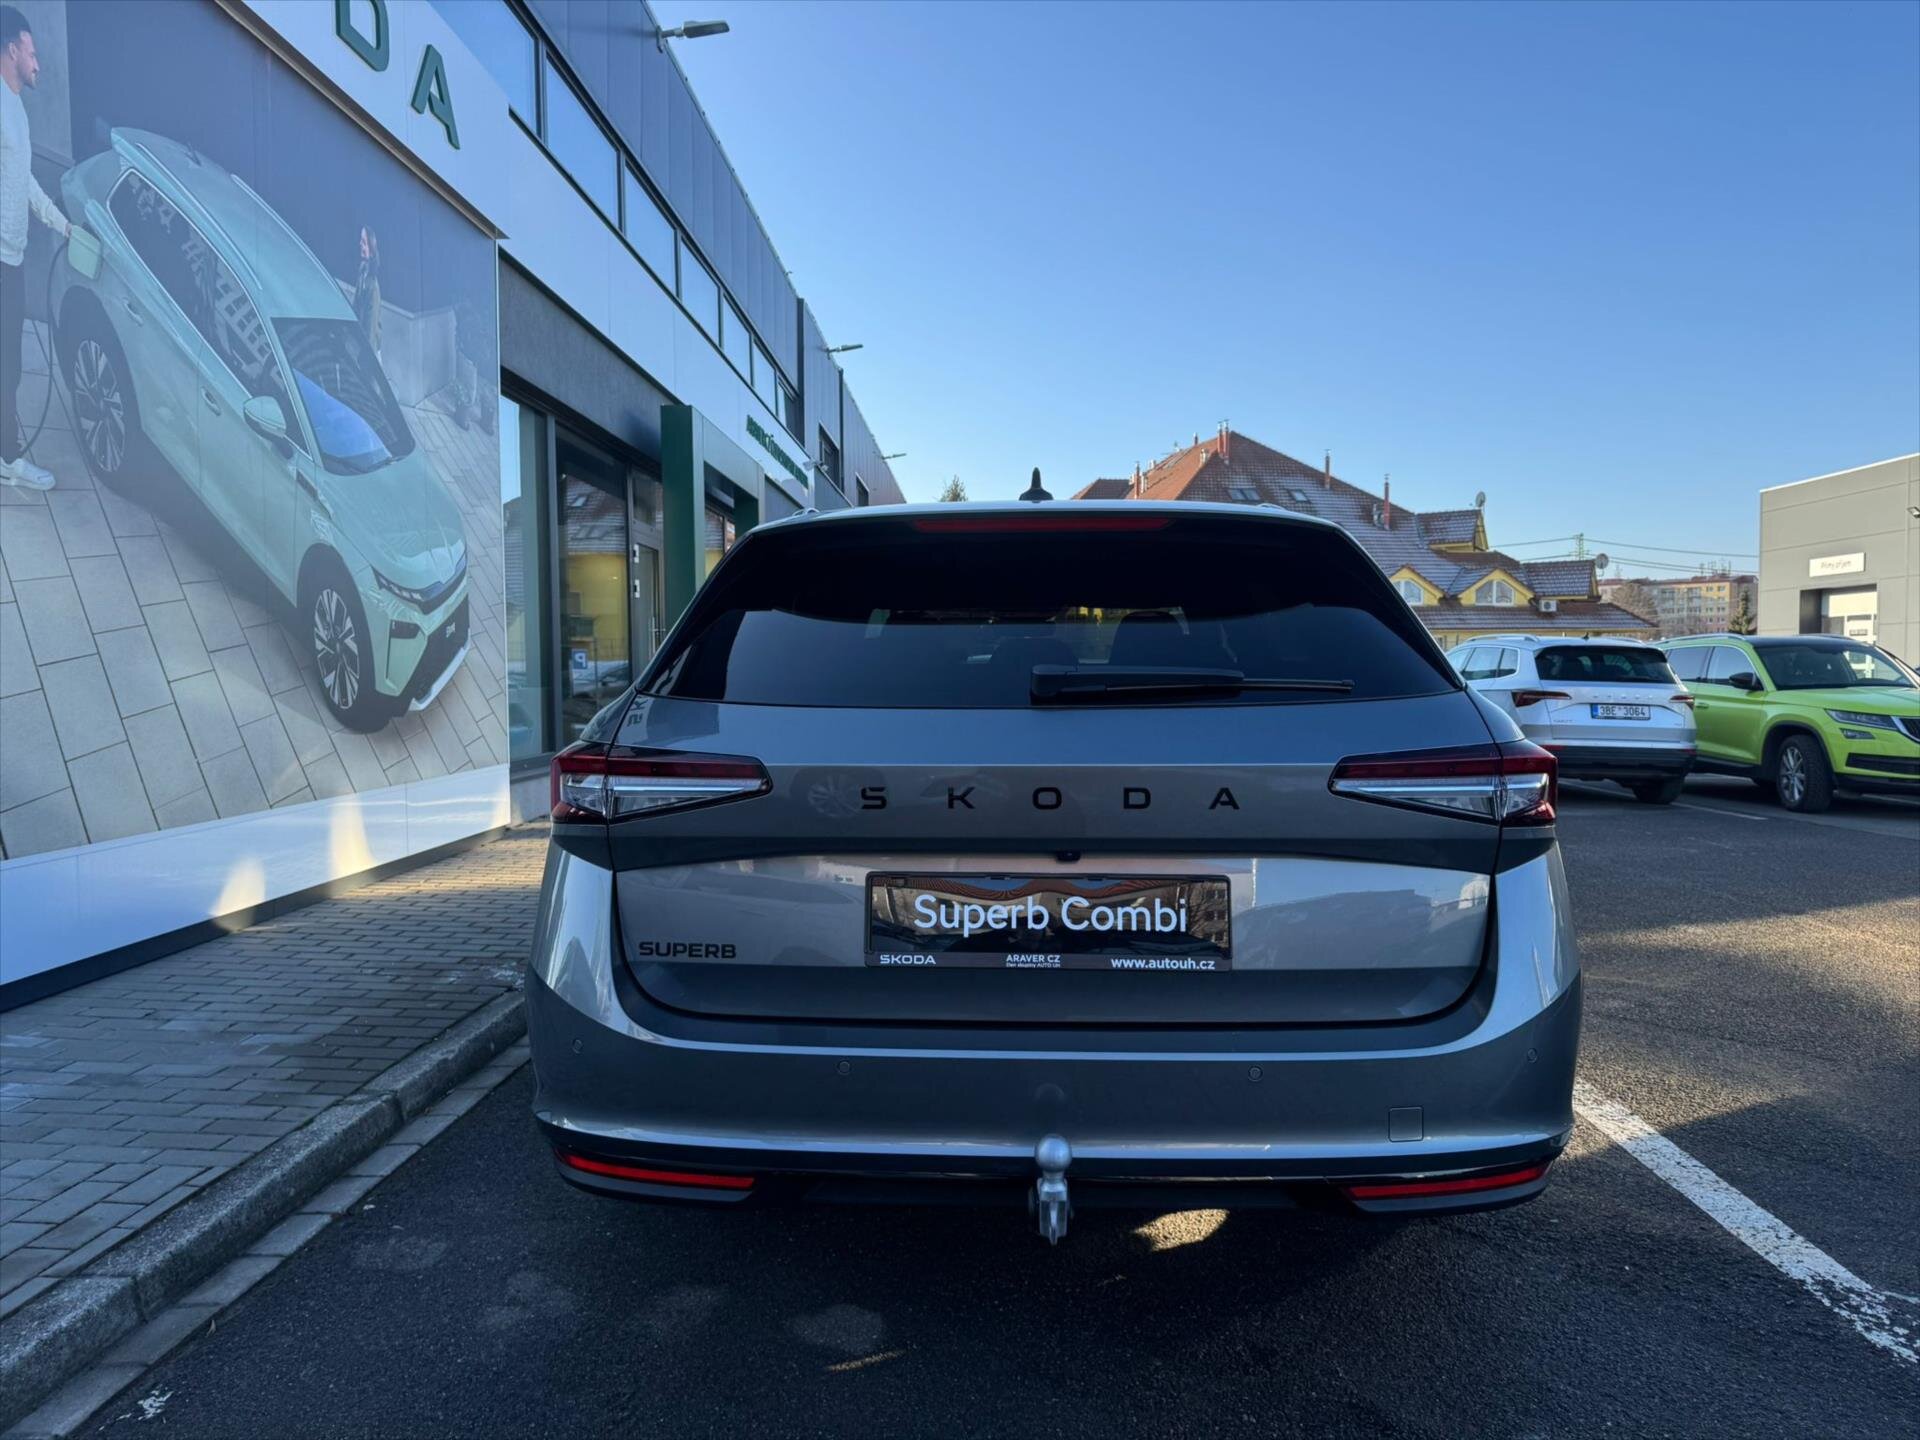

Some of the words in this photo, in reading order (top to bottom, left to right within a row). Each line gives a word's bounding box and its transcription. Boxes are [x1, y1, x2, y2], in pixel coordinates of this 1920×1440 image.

[1600, 705, 1617, 716] 3BE
[1624, 705, 1646, 716] 3064
[860, 786, 1241, 810] SKODA
[914, 894, 1049, 938] Superb
[1061, 896, 1187, 933] Combi
[638, 941, 737, 959] SUPERB
[880, 954, 937, 965] SKODA
[1006, 954, 1045, 963] ARAVER
[1047, 954, 1061, 963] CZ
[1111, 957, 1215, 970] www.autouh.cz
